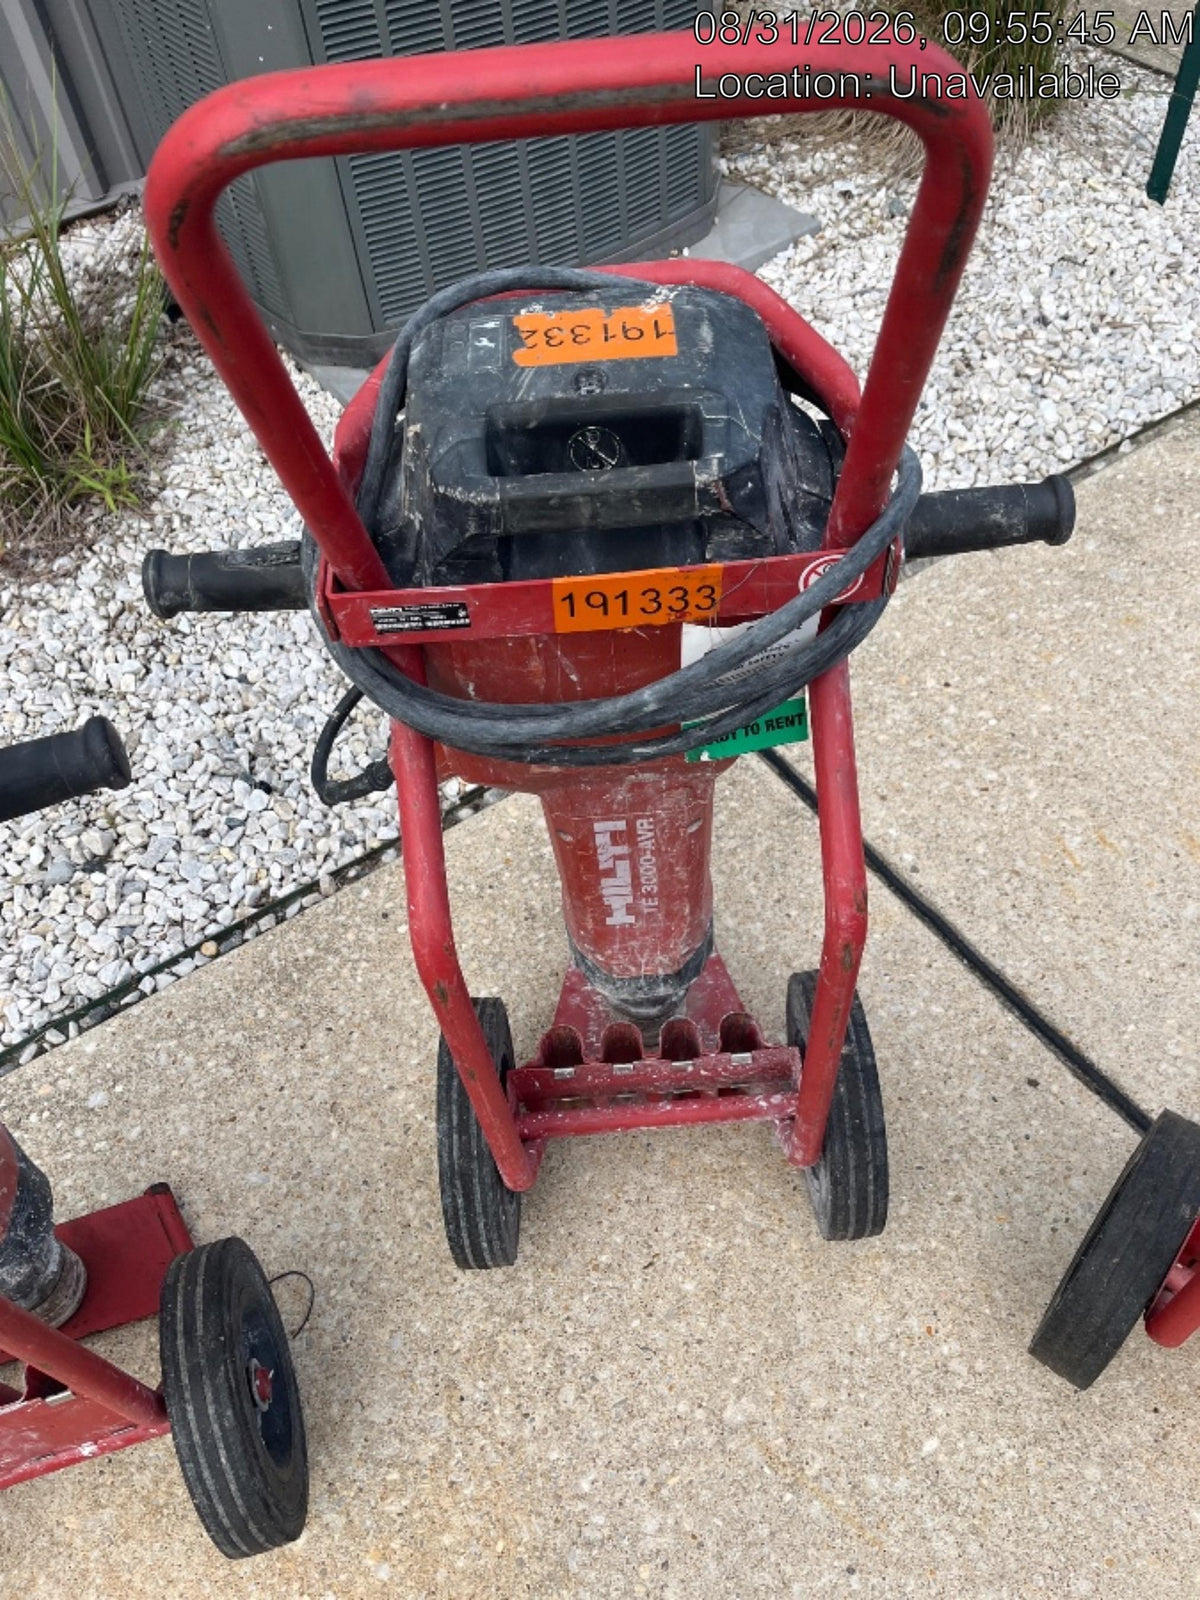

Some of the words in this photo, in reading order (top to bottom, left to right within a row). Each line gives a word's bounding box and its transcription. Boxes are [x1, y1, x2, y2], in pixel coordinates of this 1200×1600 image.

[561, 585, 716, 617] 191333
[743, 722, 760, 738] TO
[765, 713, 805, 732] RENT
[593, 820, 635, 926] HILTI
